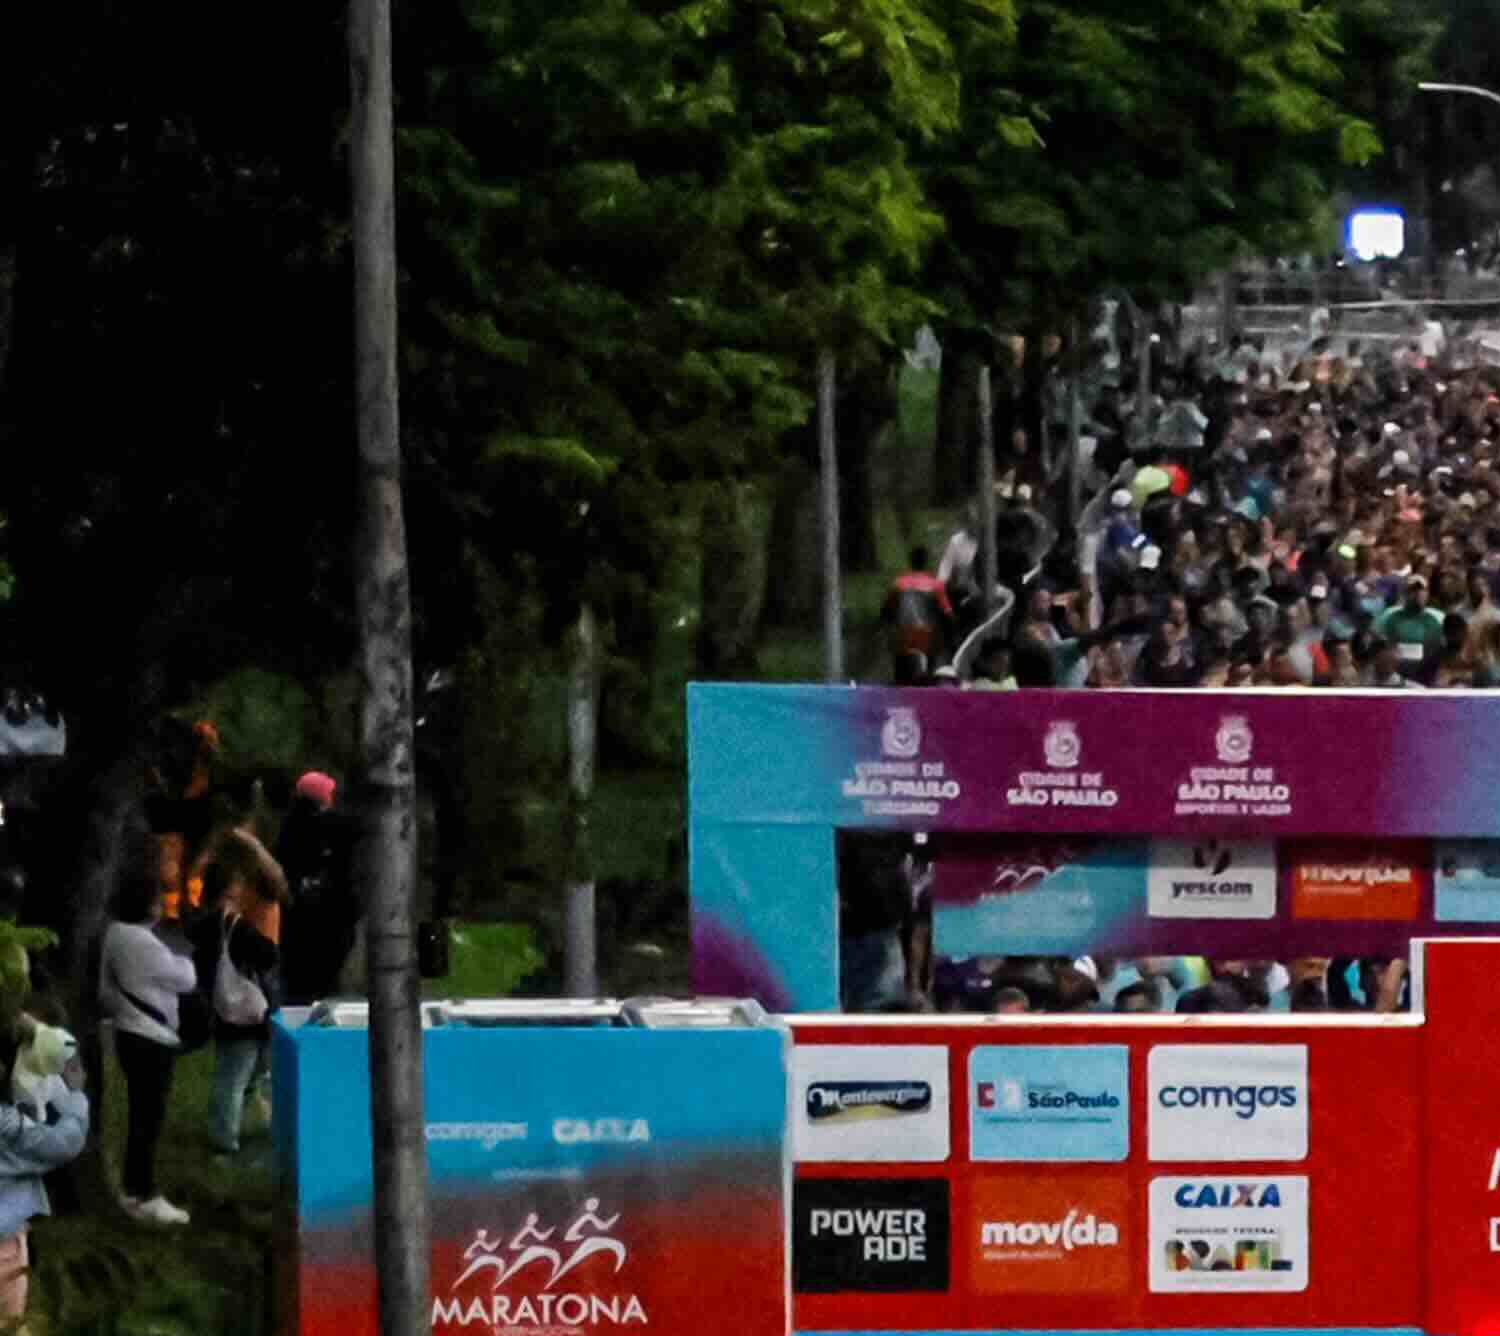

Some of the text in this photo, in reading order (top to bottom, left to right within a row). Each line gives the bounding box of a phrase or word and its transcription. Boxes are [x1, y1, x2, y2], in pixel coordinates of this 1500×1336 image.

[552, 1119, 649, 1142] CAIXA
[1174, 1184, 1281, 1209] CAIXA
[811, 1210, 926, 1237] POWER
[864, 1236, 927, 1261] ADE
[431, 1295, 648, 1325] MARATONA
